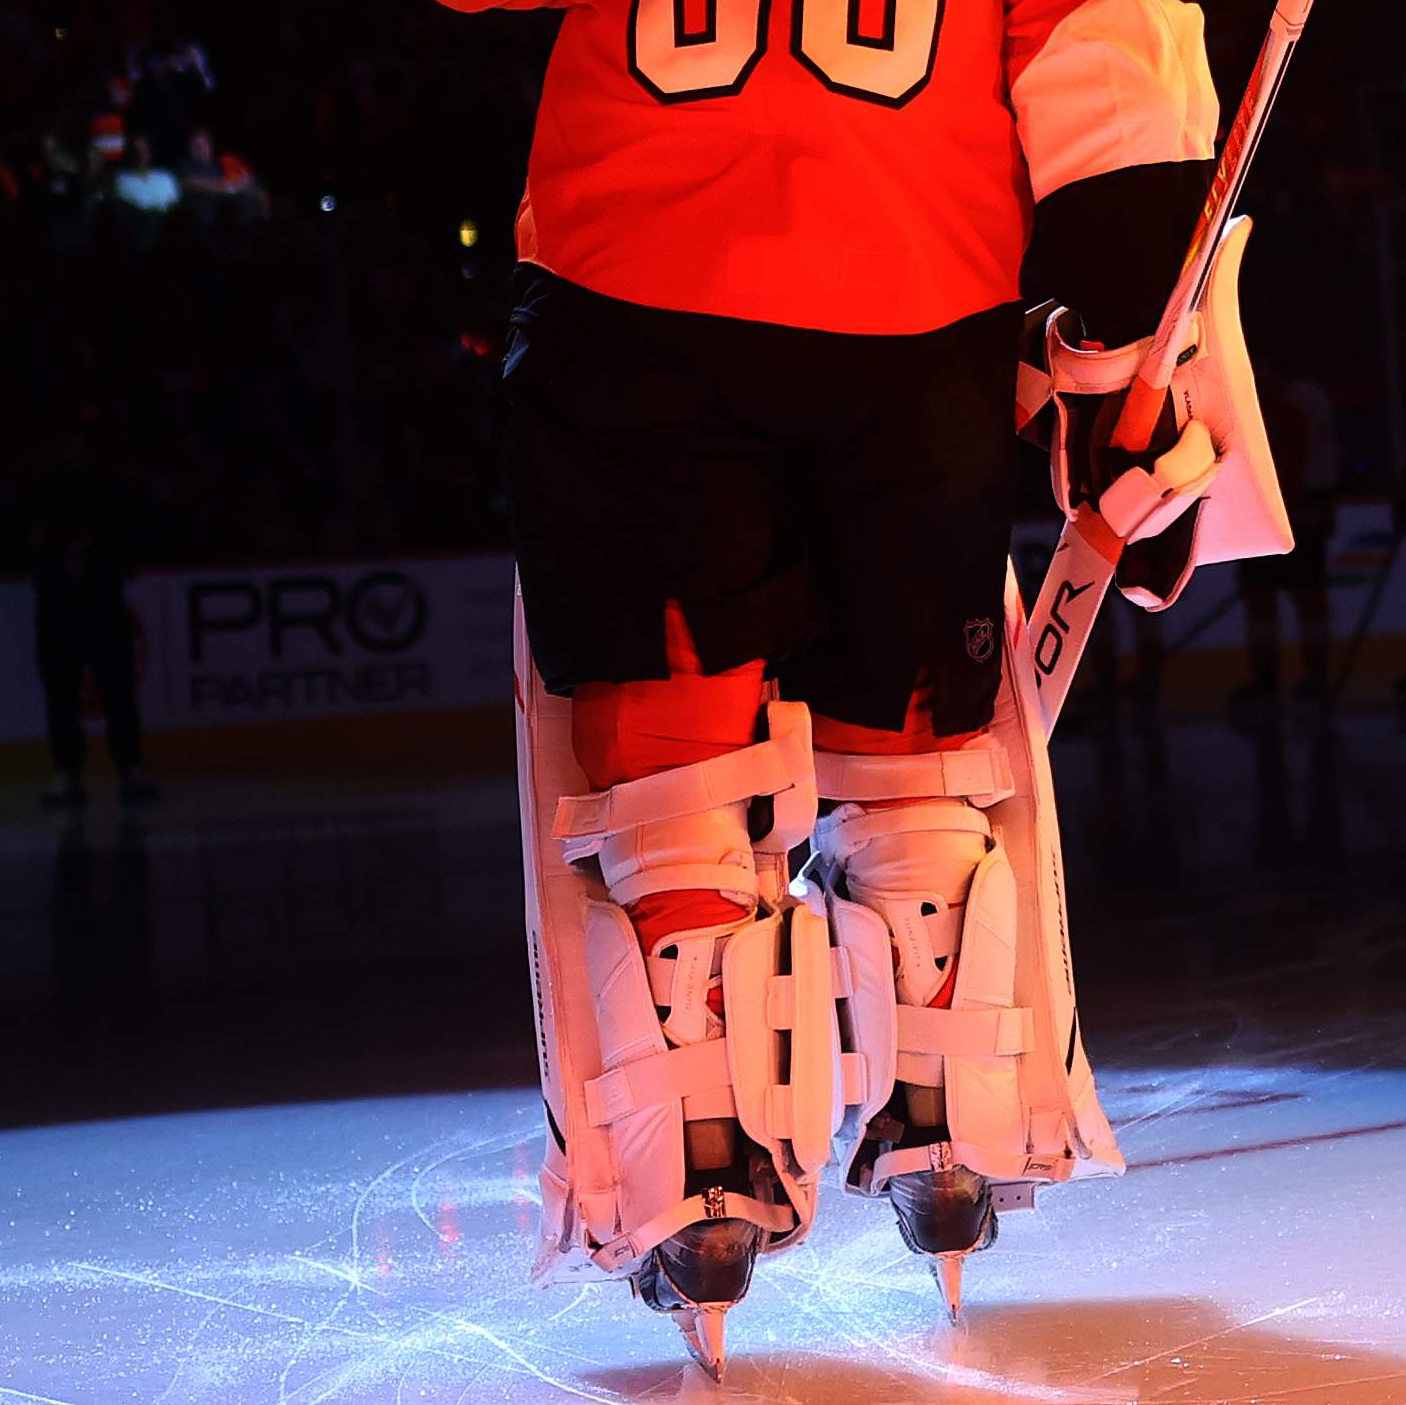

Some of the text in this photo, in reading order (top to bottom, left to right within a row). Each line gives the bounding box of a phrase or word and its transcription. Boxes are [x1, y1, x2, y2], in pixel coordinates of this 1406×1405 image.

[188, 571, 425, 663] PRO
[1034, 579, 1095, 689] OR
[190, 662, 432, 709] PARTNER
